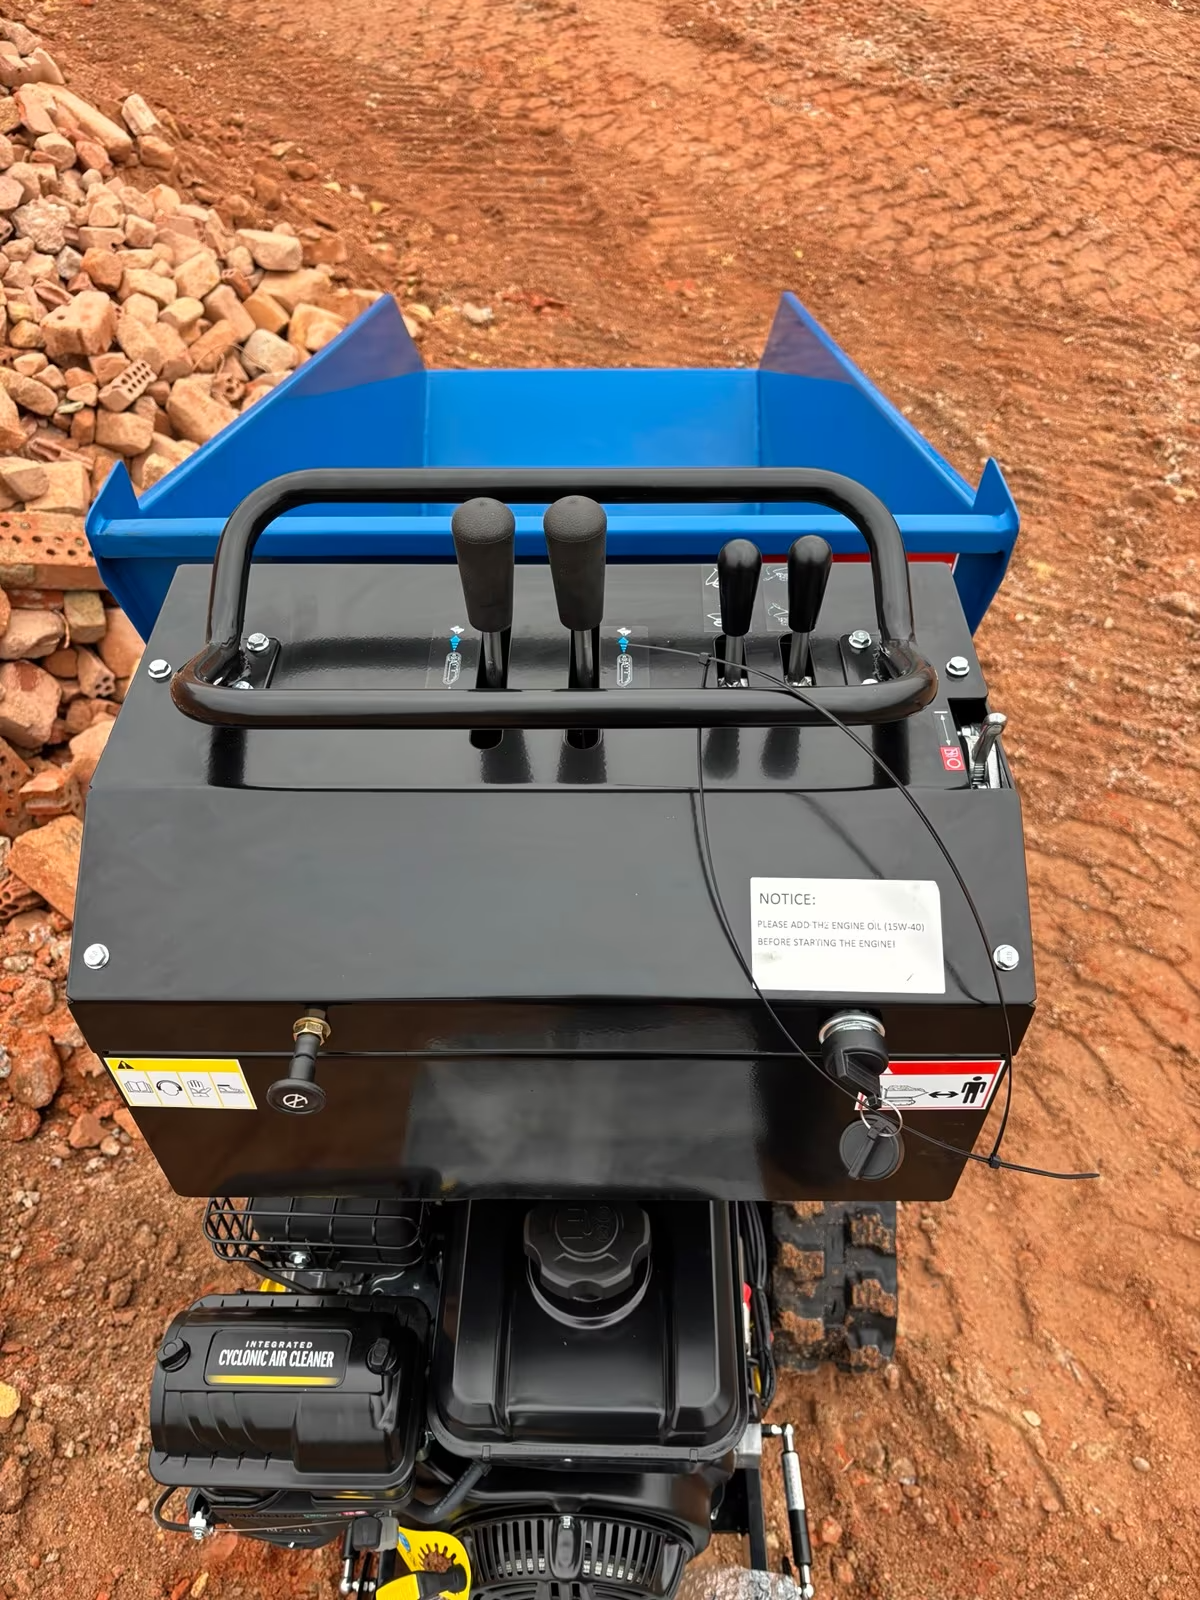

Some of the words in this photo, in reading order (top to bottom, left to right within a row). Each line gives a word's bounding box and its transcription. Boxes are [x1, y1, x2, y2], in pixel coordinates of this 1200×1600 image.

[759, 892, 816, 906] NOTICE:
[757, 919, 788, 929] PLEASE
[790, 920, 810, 930] ADD
[831, 921, 865, 931] ENGINE
[867, 921, 882, 931] OIL
[883, 922, 925, 933] (15W-40)
[757, 937, 791, 947] BEFORE
[793, 938, 837, 948] STARTING
[840, 939, 856, 948] THE
[219, 1349, 268, 1366] CYCLONIC
[269, 1350, 287, 1366] AIR
[289, 1351, 334, 1367] CLEANER
